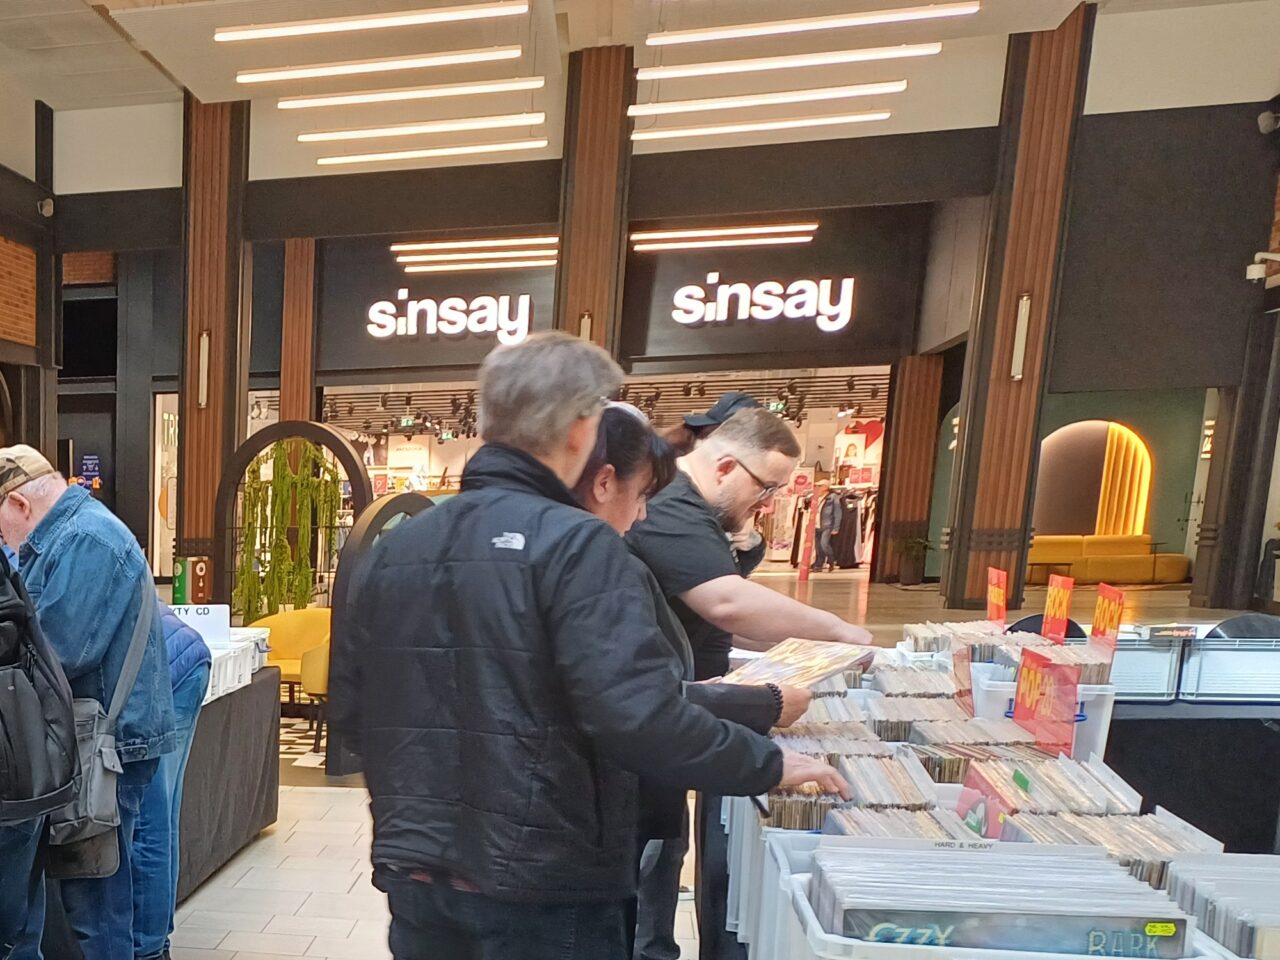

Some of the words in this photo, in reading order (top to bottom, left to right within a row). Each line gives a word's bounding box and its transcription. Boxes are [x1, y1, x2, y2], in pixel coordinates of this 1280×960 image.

[366, 288, 530, 345] sinsay
[671, 272, 855, 332] sinsay
[196, 607, 210, 616] CD
[1046, 585, 1070, 620] ROCK
[1095, 595, 1122, 632] ROCK
